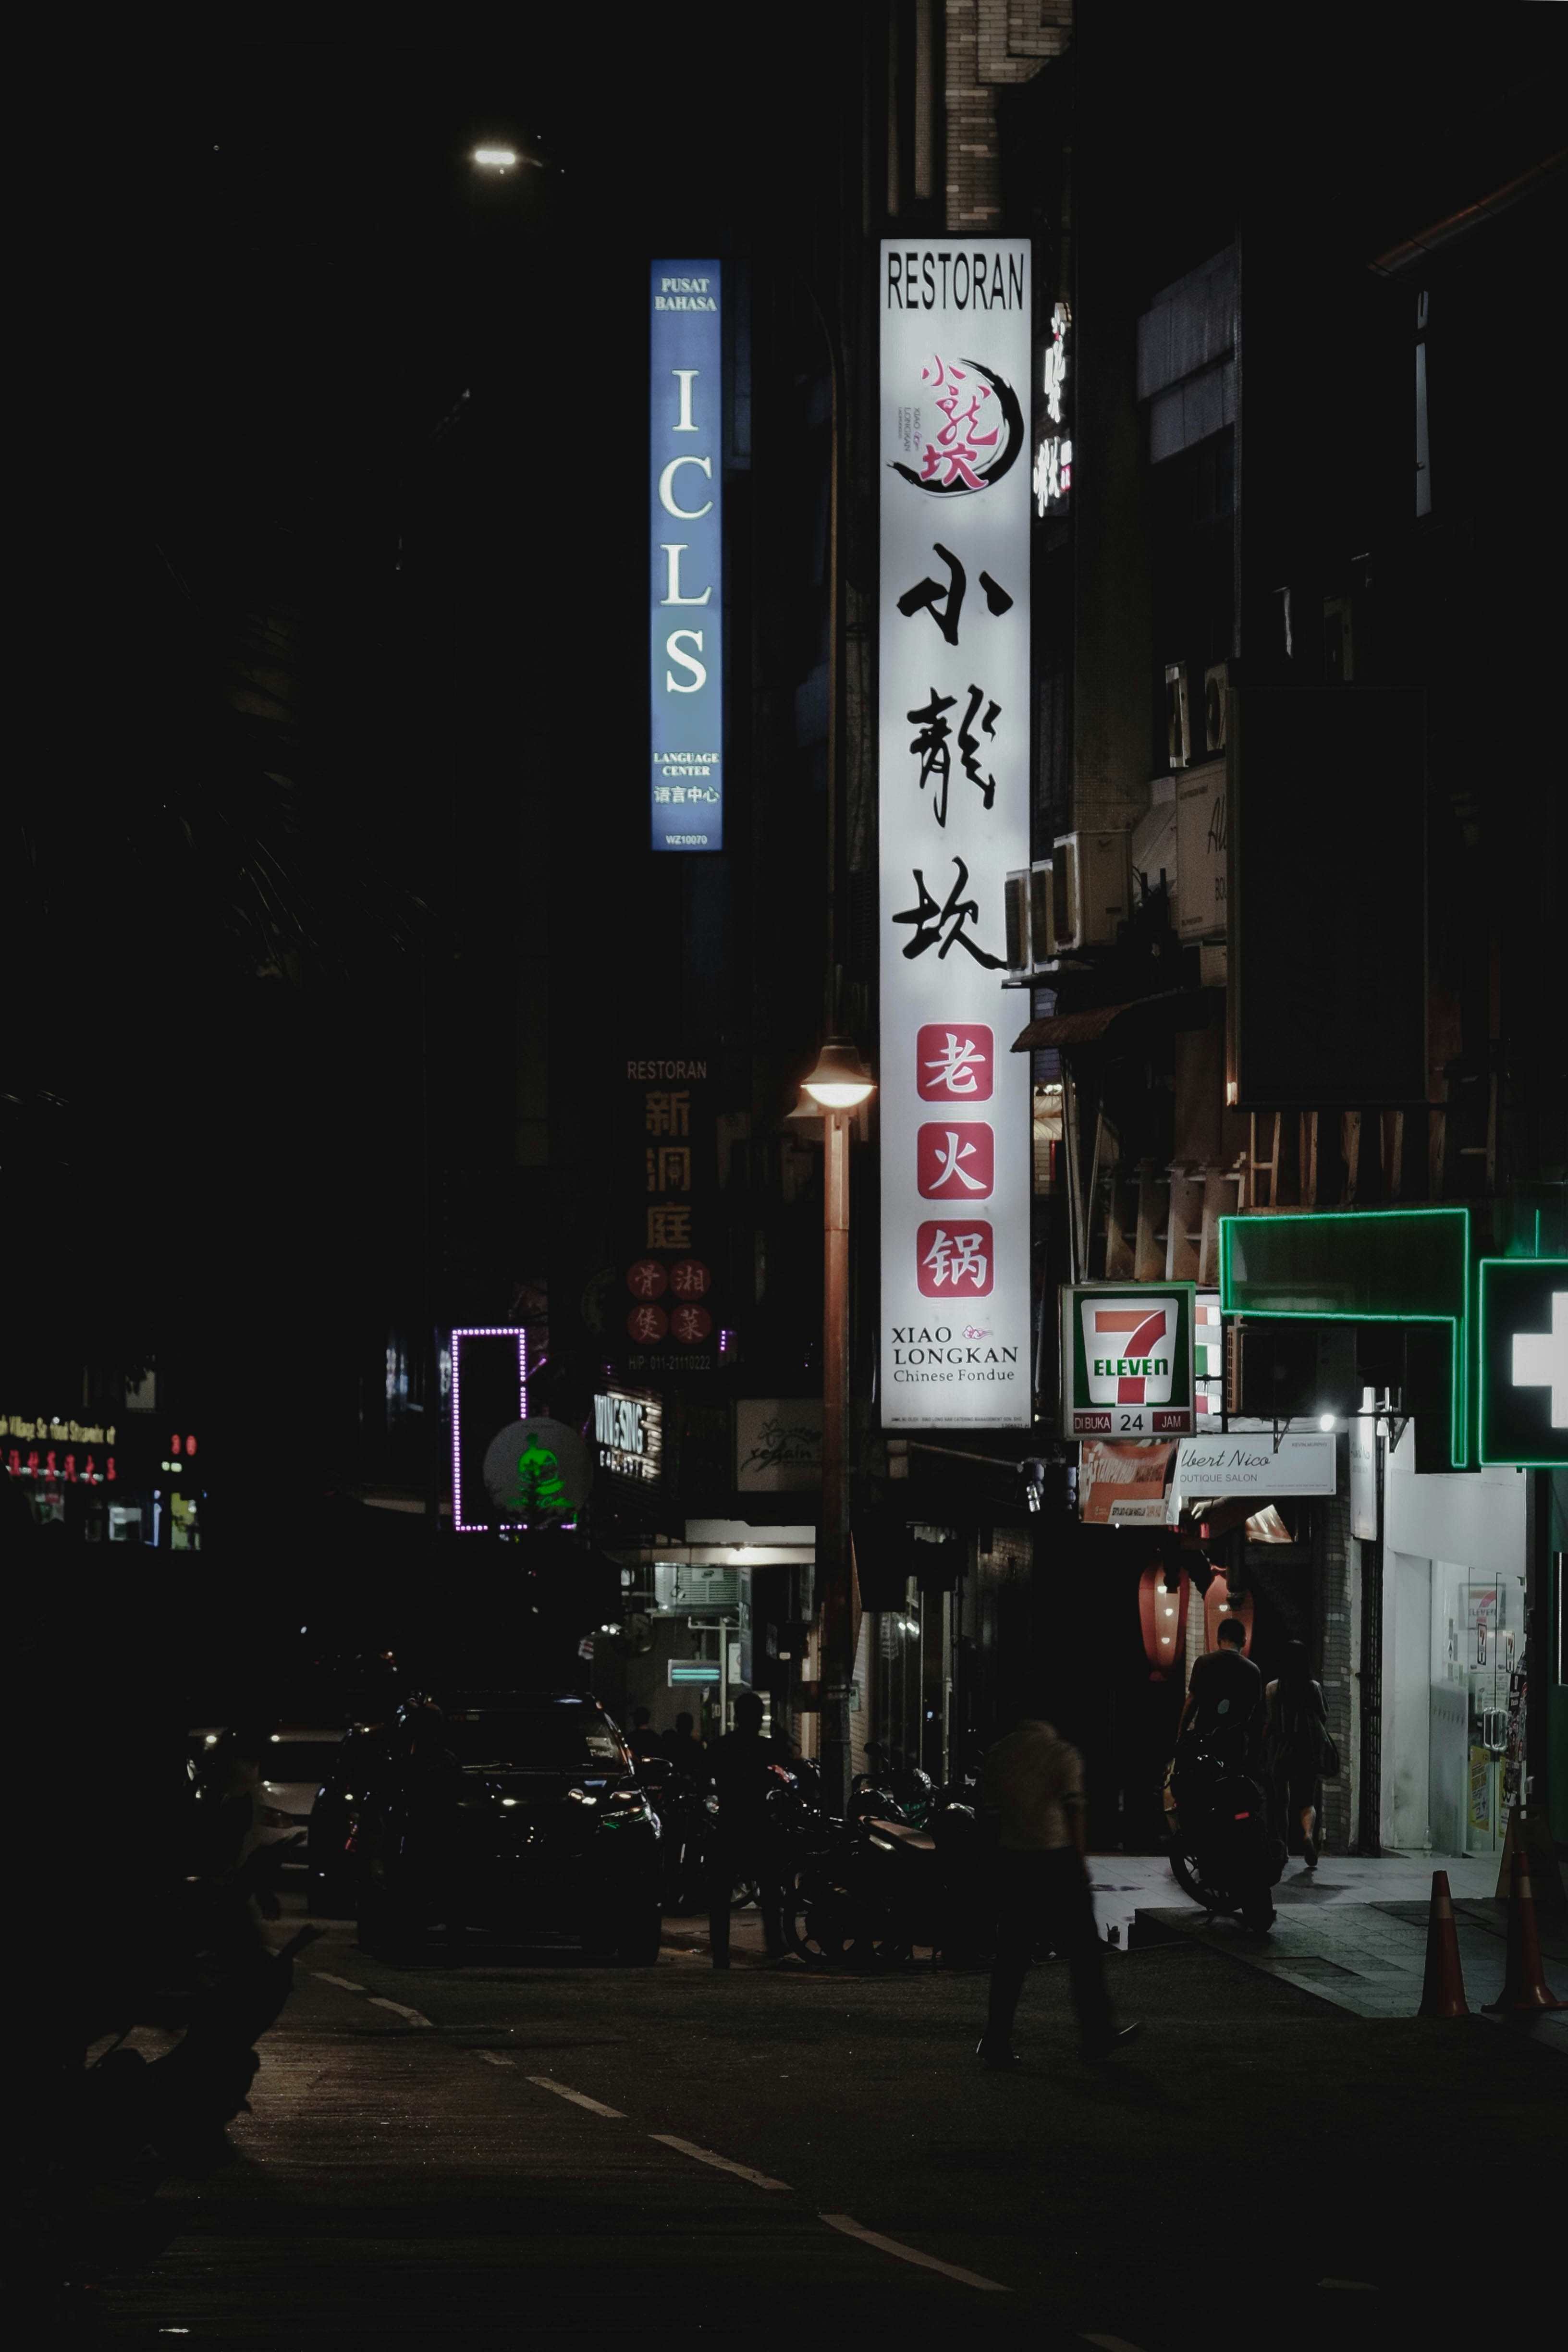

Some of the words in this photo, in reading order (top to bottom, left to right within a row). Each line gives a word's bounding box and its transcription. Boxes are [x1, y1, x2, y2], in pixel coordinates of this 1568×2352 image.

[662, 278, 710, 293] PUSAT
[887, 252, 1024, 310] RESTORAN
[654, 296, 717, 311] BAHASA
[659, 369, 713, 693] ICLS
[653, 752, 719, 763] LANGUAGE
[662, 765, 710, 776] CENTER
[654, 785, 720, 804] 语言中心
[627, 1060, 708, 1079] RESTORAN
[922, 1033, 987, 1288] 老火锅
[646, 1090, 692, 1250] 新洞庭
[892, 1326, 952, 1343] XIAO
[894, 1347, 1018, 1365] LONGKAN
[1095, 1310, 1166, 1404] 7
[894, 1370, 954, 1383] Chinese
[958, 1369, 1015, 1382] Fondue
[1075, 1418, 1084, 1430] DI
[1085, 1416, 1111, 1430] BUKA
[1120, 1414, 1143, 1431] 24
[1162, 1415, 1181, 1429] JAM
[1181, 1449, 1225, 1467] lbert
[1227, 1449, 1271, 1467] Nico
[1180, 1474, 1223, 1483] OUTIQUE
[1225, 1474, 1257, 1482] SALON
